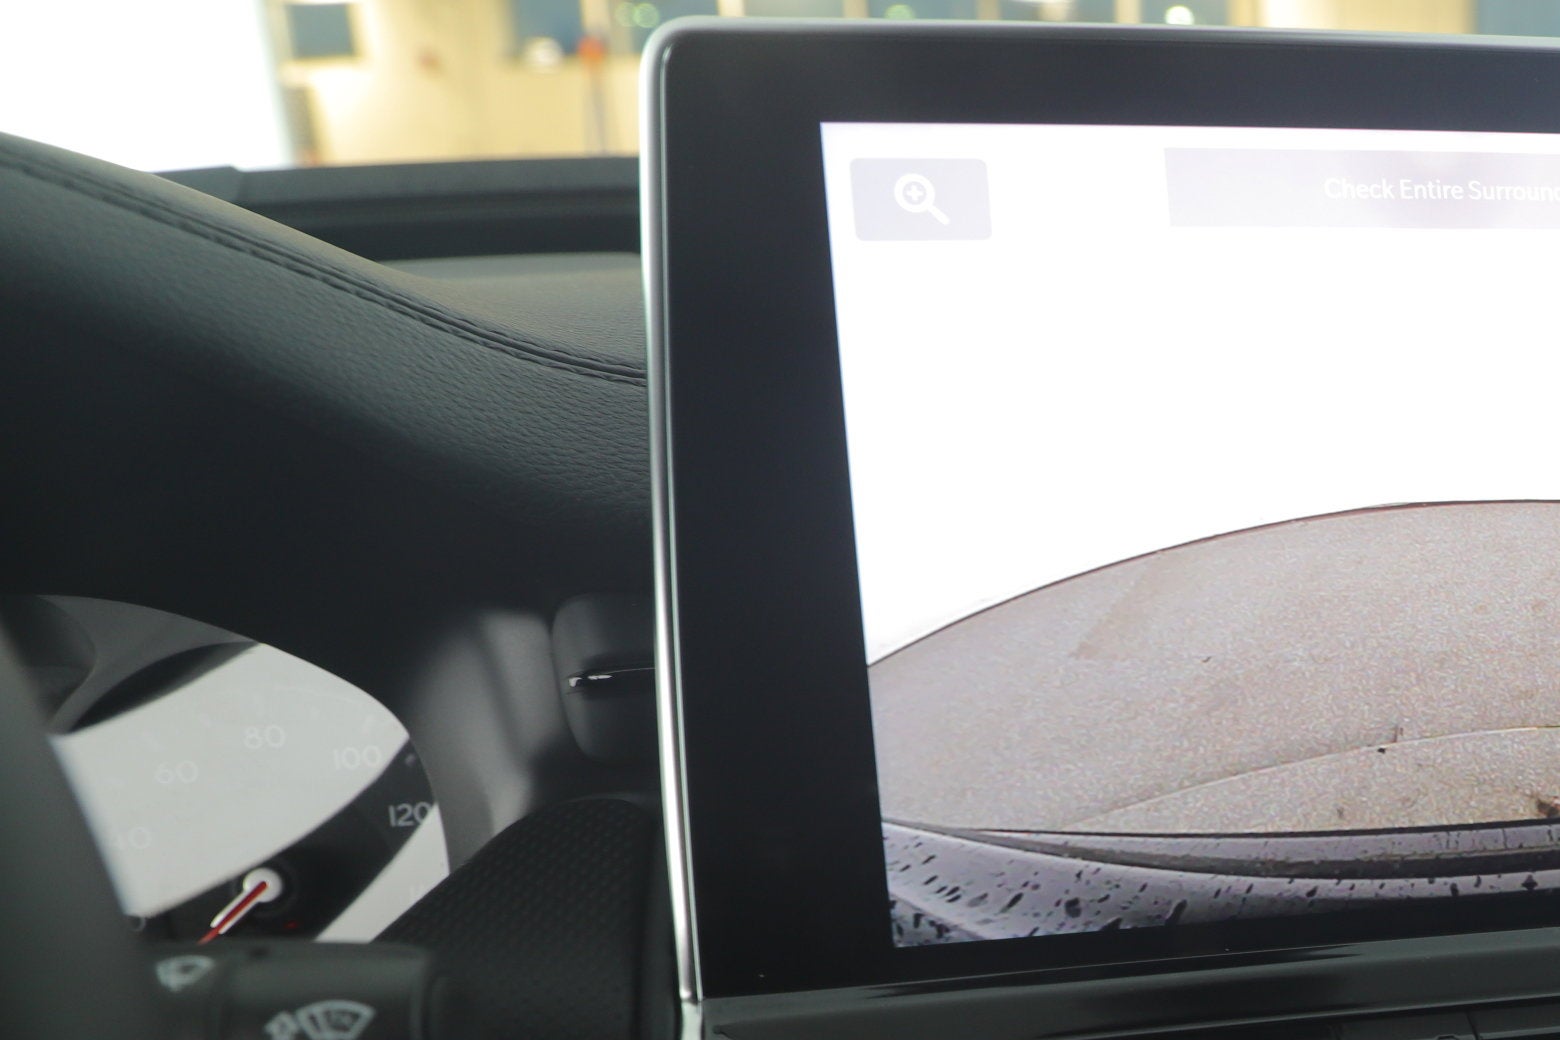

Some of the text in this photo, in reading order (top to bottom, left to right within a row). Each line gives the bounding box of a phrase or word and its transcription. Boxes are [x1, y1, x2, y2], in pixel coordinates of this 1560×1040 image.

[1323, 176, 1394, 200] Check
[1399, 178, 1464, 201] Entire
[243, 723, 287, 750] 80
[332, 744, 383, 771] 100
[153, 759, 199, 785] 60
[387, 800, 435, 828] 120
